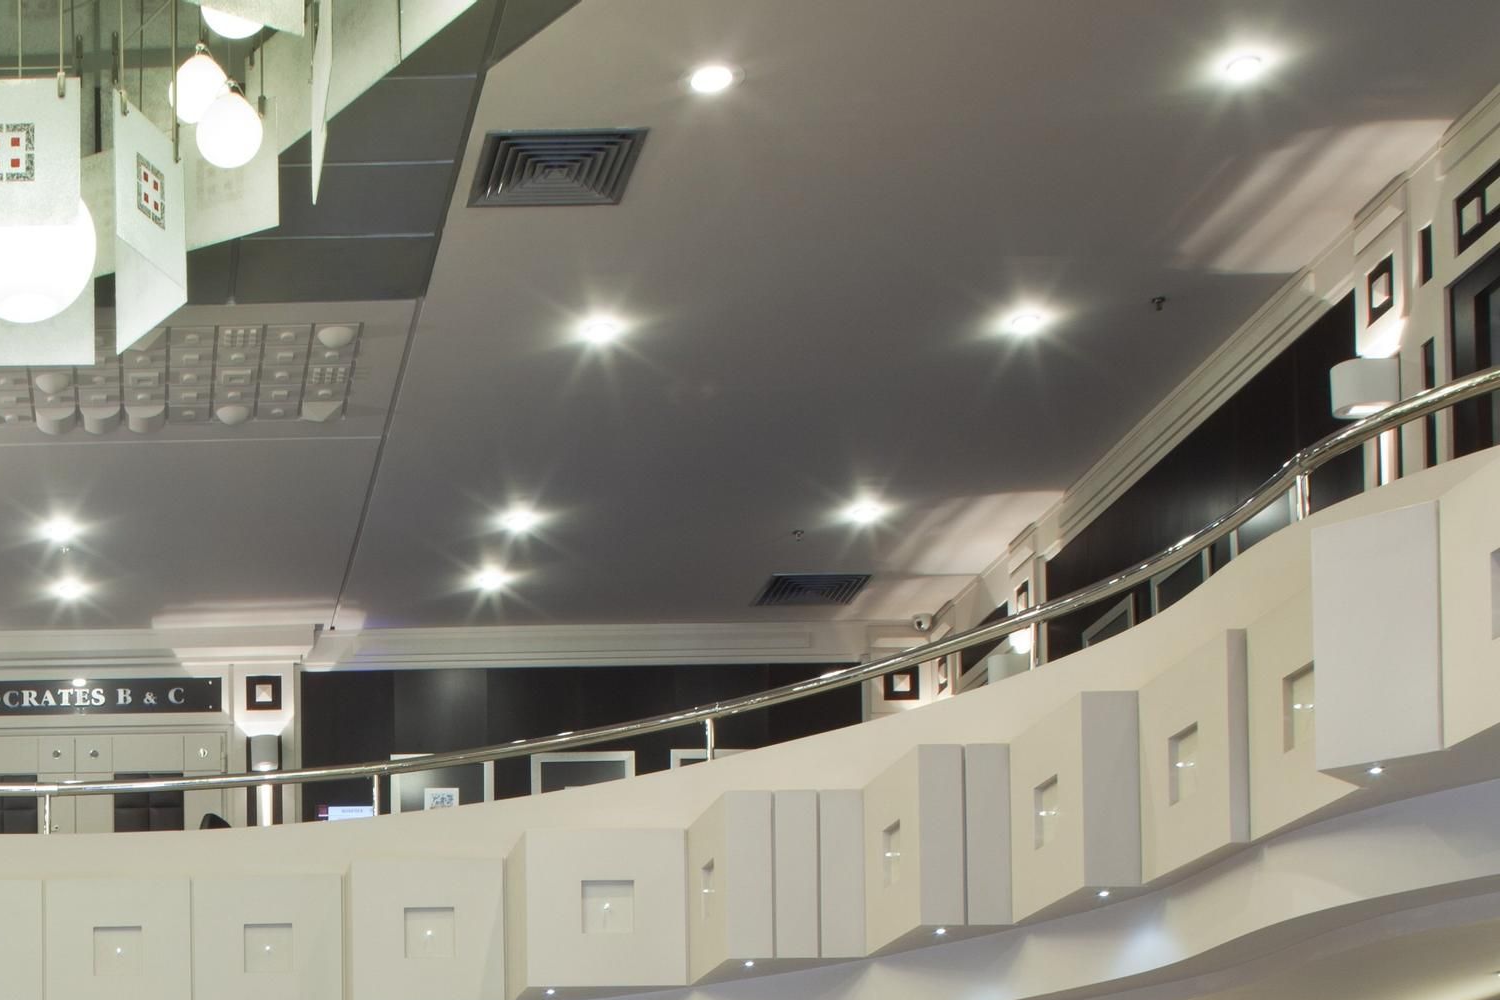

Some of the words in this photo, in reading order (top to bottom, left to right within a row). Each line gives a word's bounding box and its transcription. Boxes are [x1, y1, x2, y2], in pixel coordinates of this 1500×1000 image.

[116, 688, 133, 705] B
[143, 691, 157, 705] &
[168, 687, 185, 704] C
